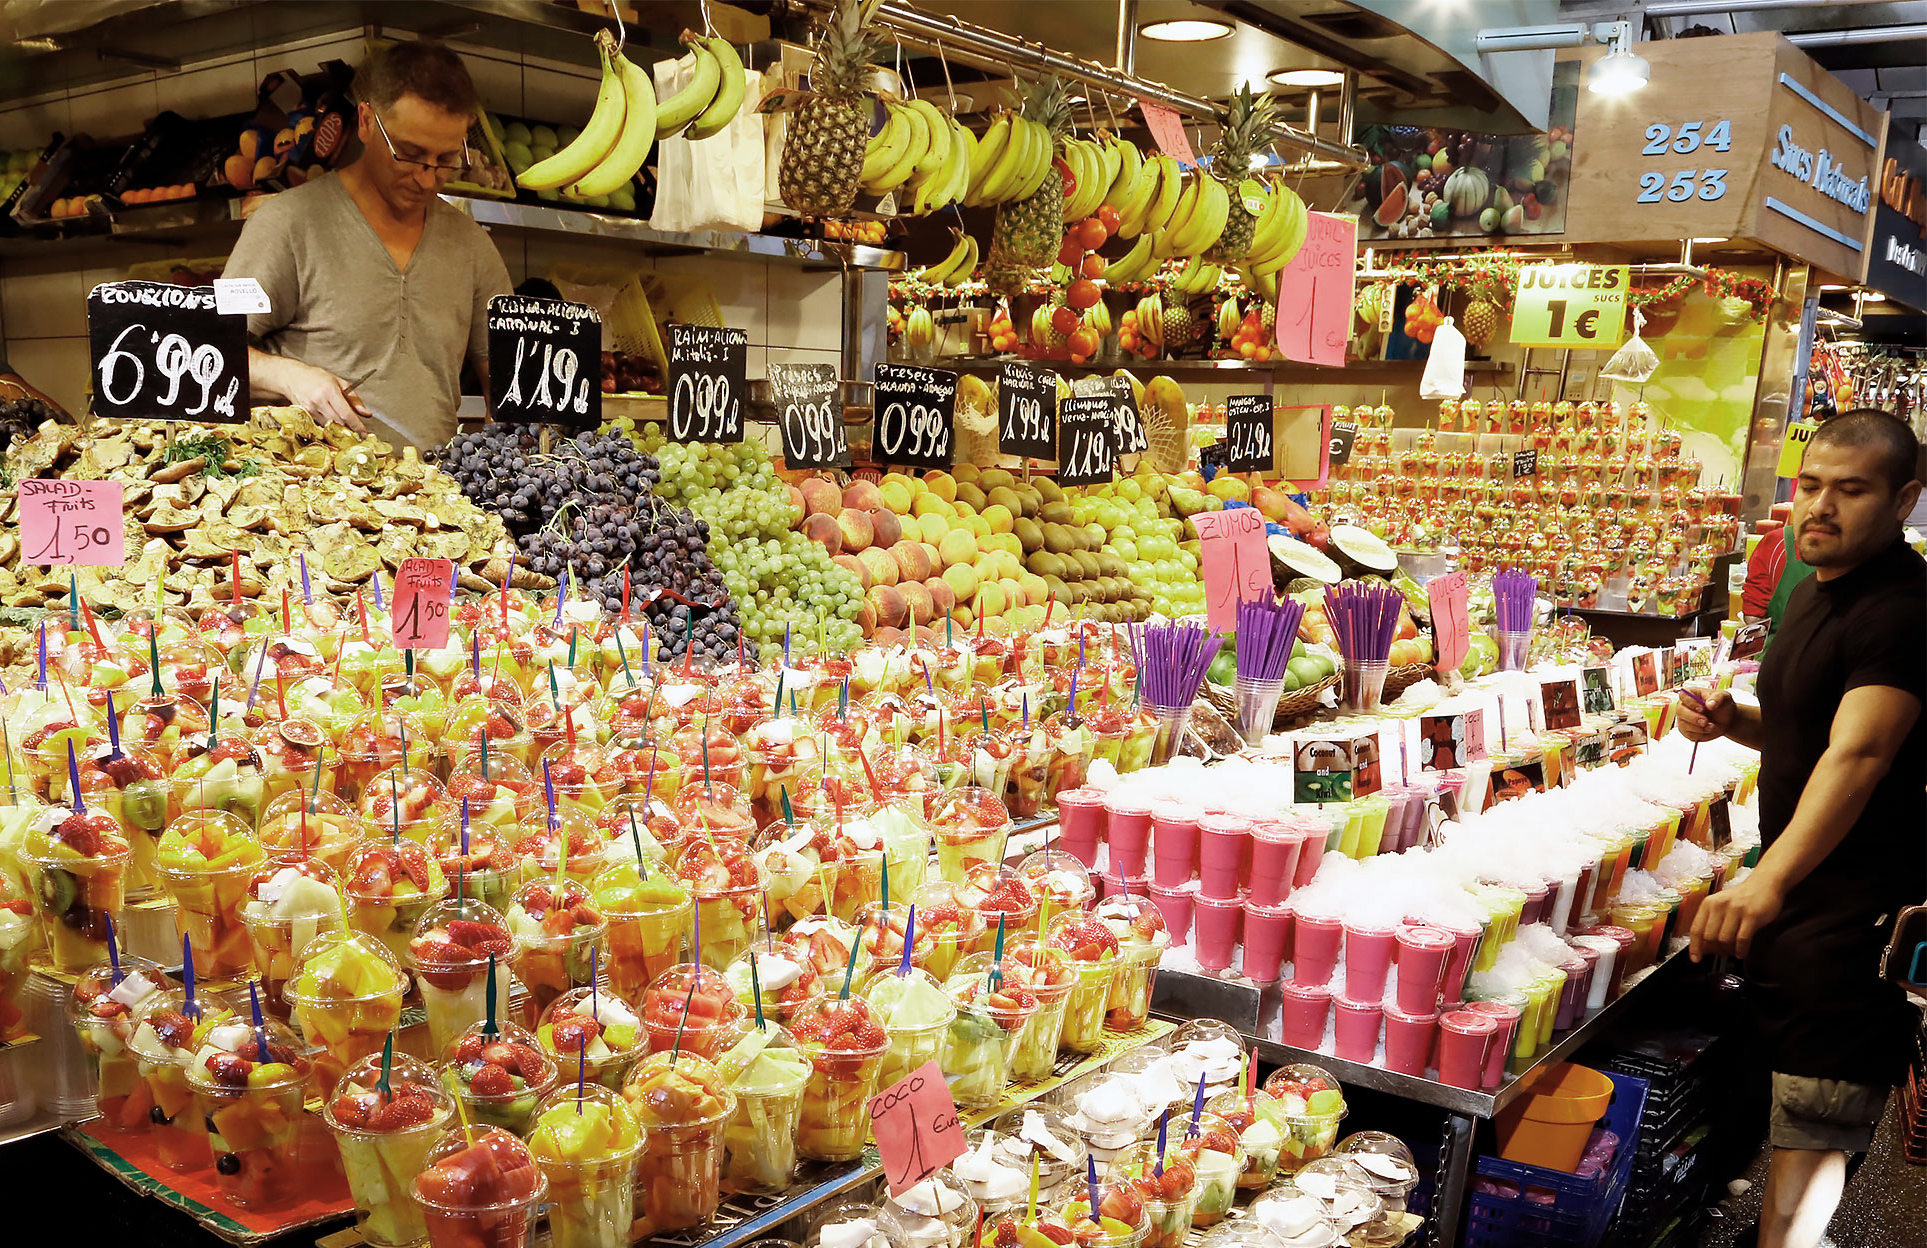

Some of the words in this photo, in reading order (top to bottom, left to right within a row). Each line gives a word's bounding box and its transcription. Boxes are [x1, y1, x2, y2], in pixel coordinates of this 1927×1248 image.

[315, 114, 342, 156] TROPS
[1643, 120, 1732, 155] 254
[1637, 169, 1728, 203] 253
[1772, 124, 1813, 182] Sucs
[1811, 148, 1870, 215] Naturals
[1522, 268, 1620, 289] JUICES
[1593, 294, 1620, 302] SUCS
[1547, 300, 1567, 338] 1
[1573, 310, 1600, 339] €
[1229, 396, 1256, 406] MANGOS
[1195, 511, 1261, 540] ZUMOS
[1309, 747, 1336, 758] Coconut
[1316, 766, 1330, 777] and
[871, 1077, 925, 1120] COCO
[897, 1102, 936, 1185] 1
